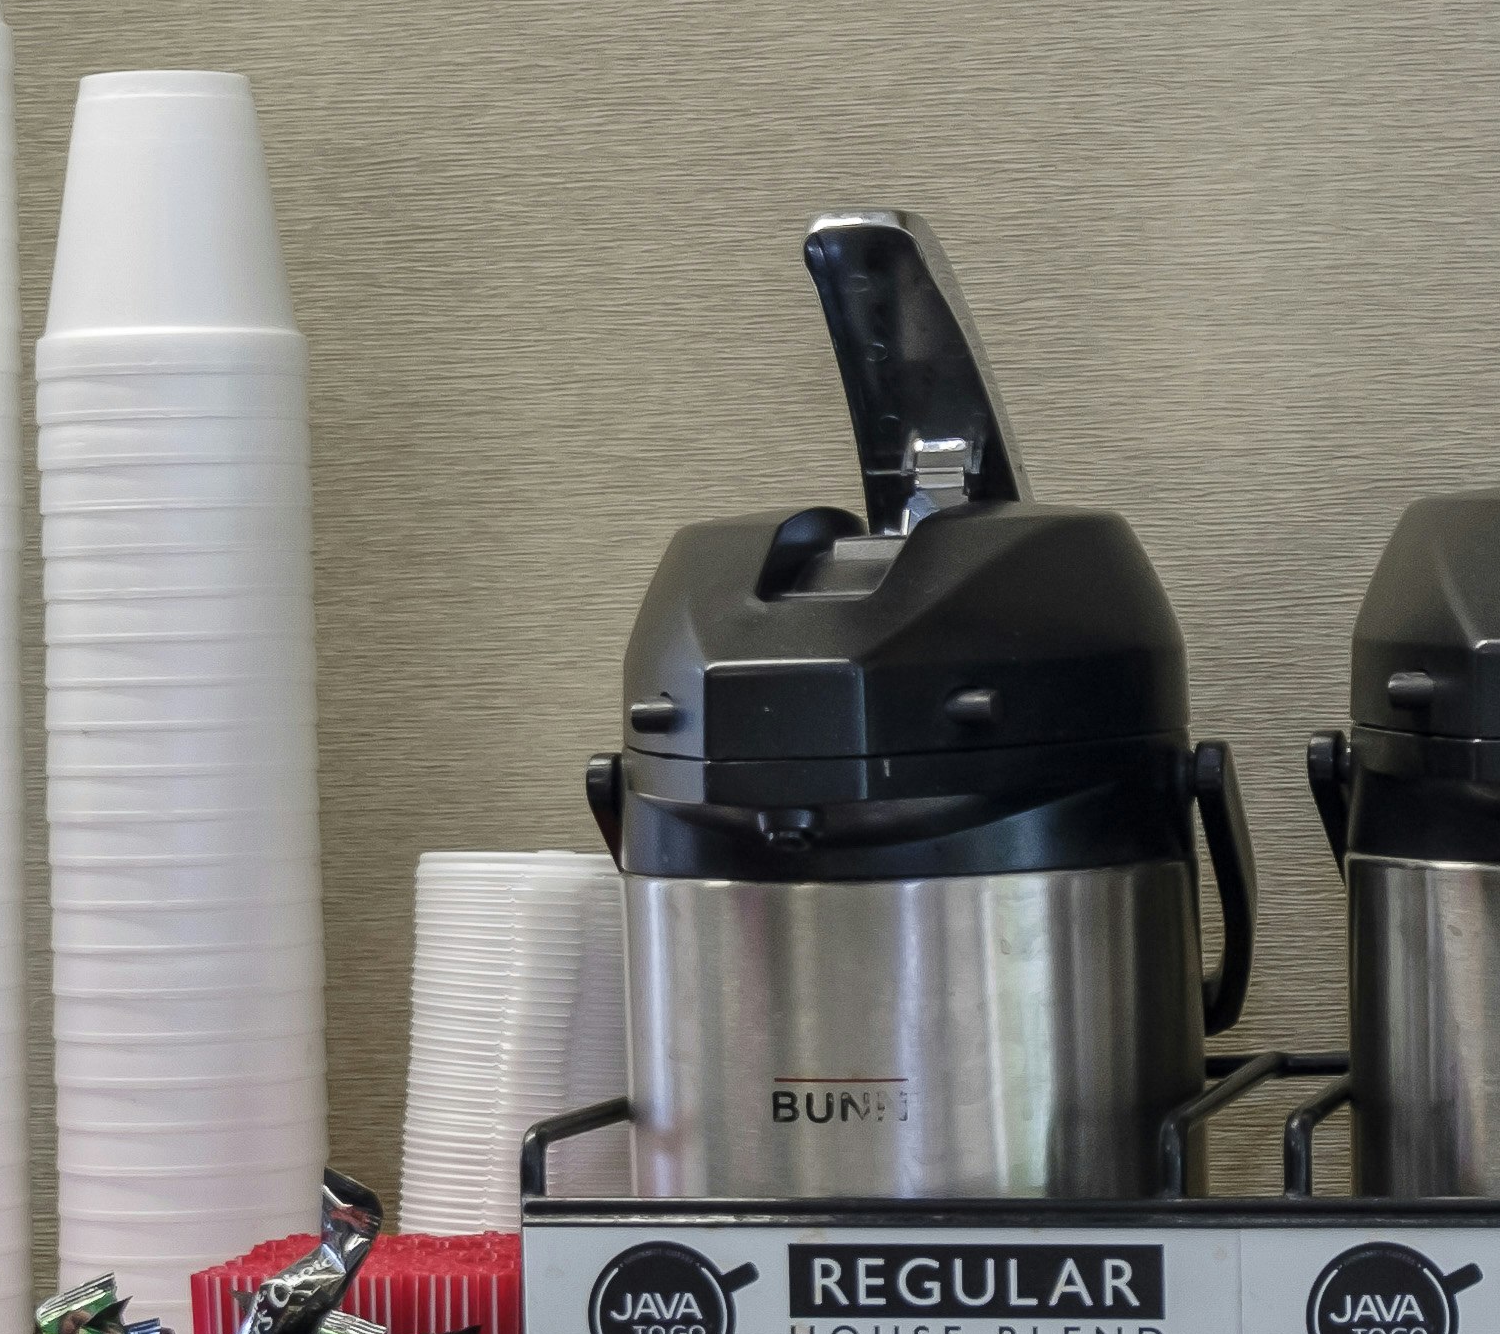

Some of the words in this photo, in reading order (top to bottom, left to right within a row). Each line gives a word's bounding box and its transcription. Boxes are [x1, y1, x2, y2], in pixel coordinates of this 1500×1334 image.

[811, 1257, 1142, 1308] REGULAR
[610, 1292, 703, 1321] JAVA
[1329, 1294, 1425, 1323] JAVA
